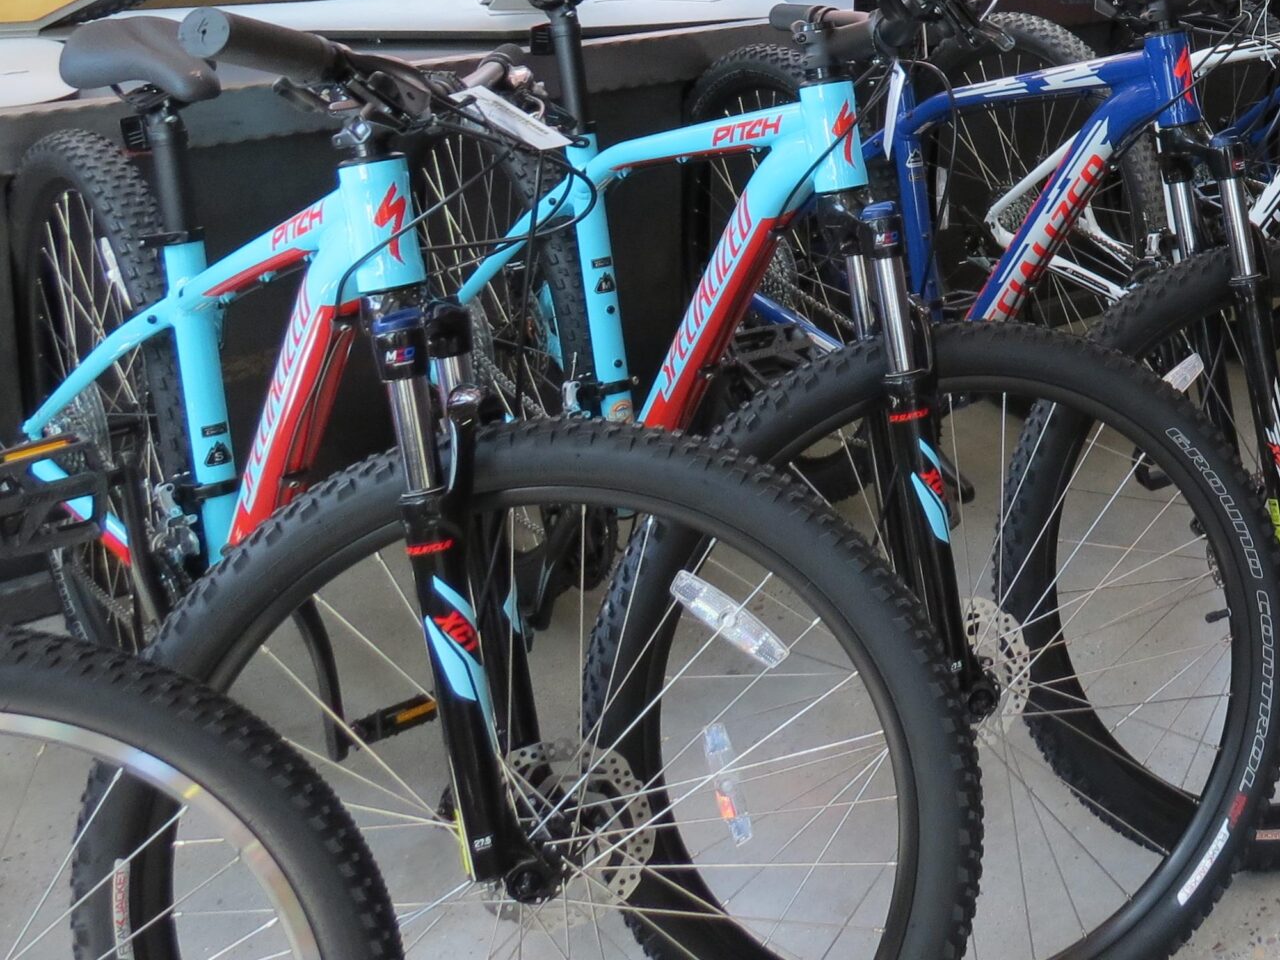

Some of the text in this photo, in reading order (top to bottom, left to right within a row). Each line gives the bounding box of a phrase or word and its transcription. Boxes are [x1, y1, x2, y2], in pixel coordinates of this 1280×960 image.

[712, 114, 784, 147] PITCH
[271, 201, 325, 251] PITCH
[652, 189, 752, 397] SPECIALIZED
[1165, 427, 1275, 792] GROUND CONTROL
